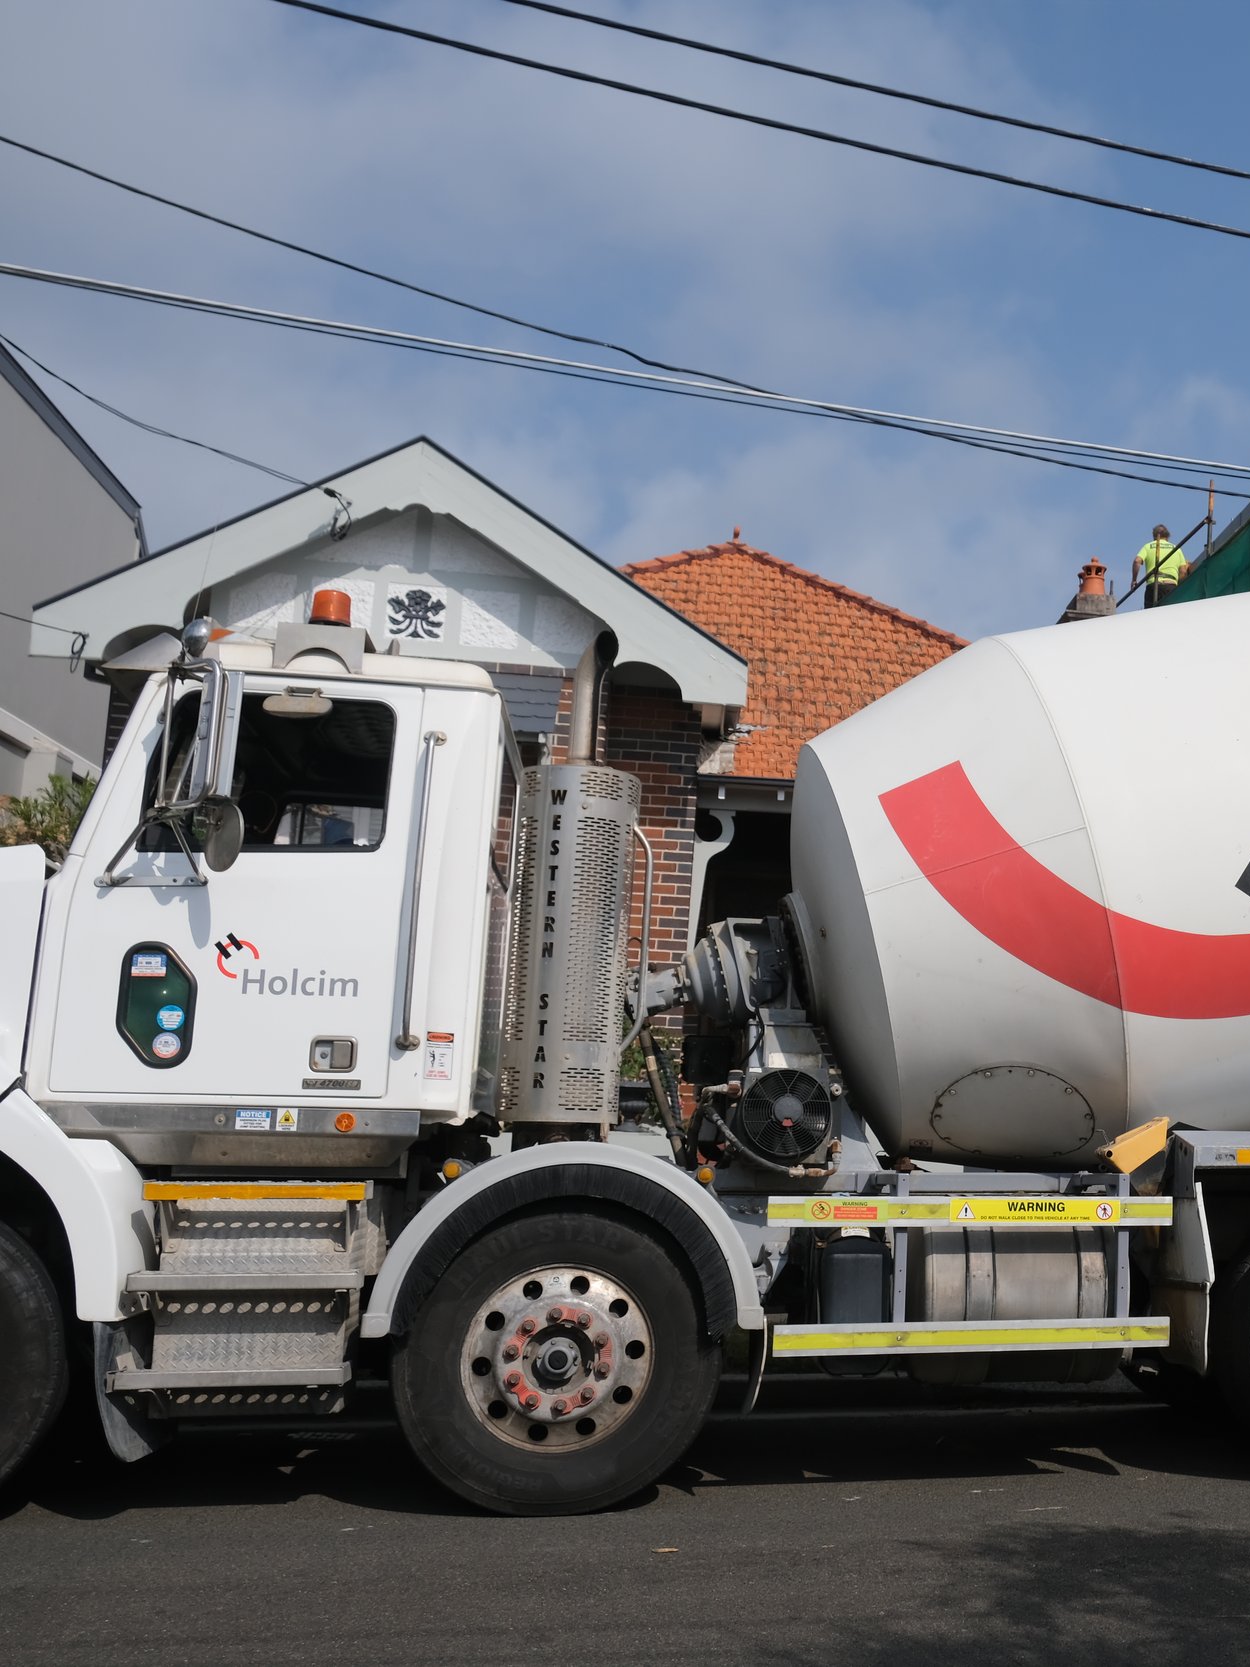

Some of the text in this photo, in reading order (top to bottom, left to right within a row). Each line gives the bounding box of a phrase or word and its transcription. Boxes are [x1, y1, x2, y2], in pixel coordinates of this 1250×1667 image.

[533, 789, 566, 1089] WESTERN STAR
[241, 968, 359, 997] Holcim
[1008, 1202, 1066, 1212] WARNING
